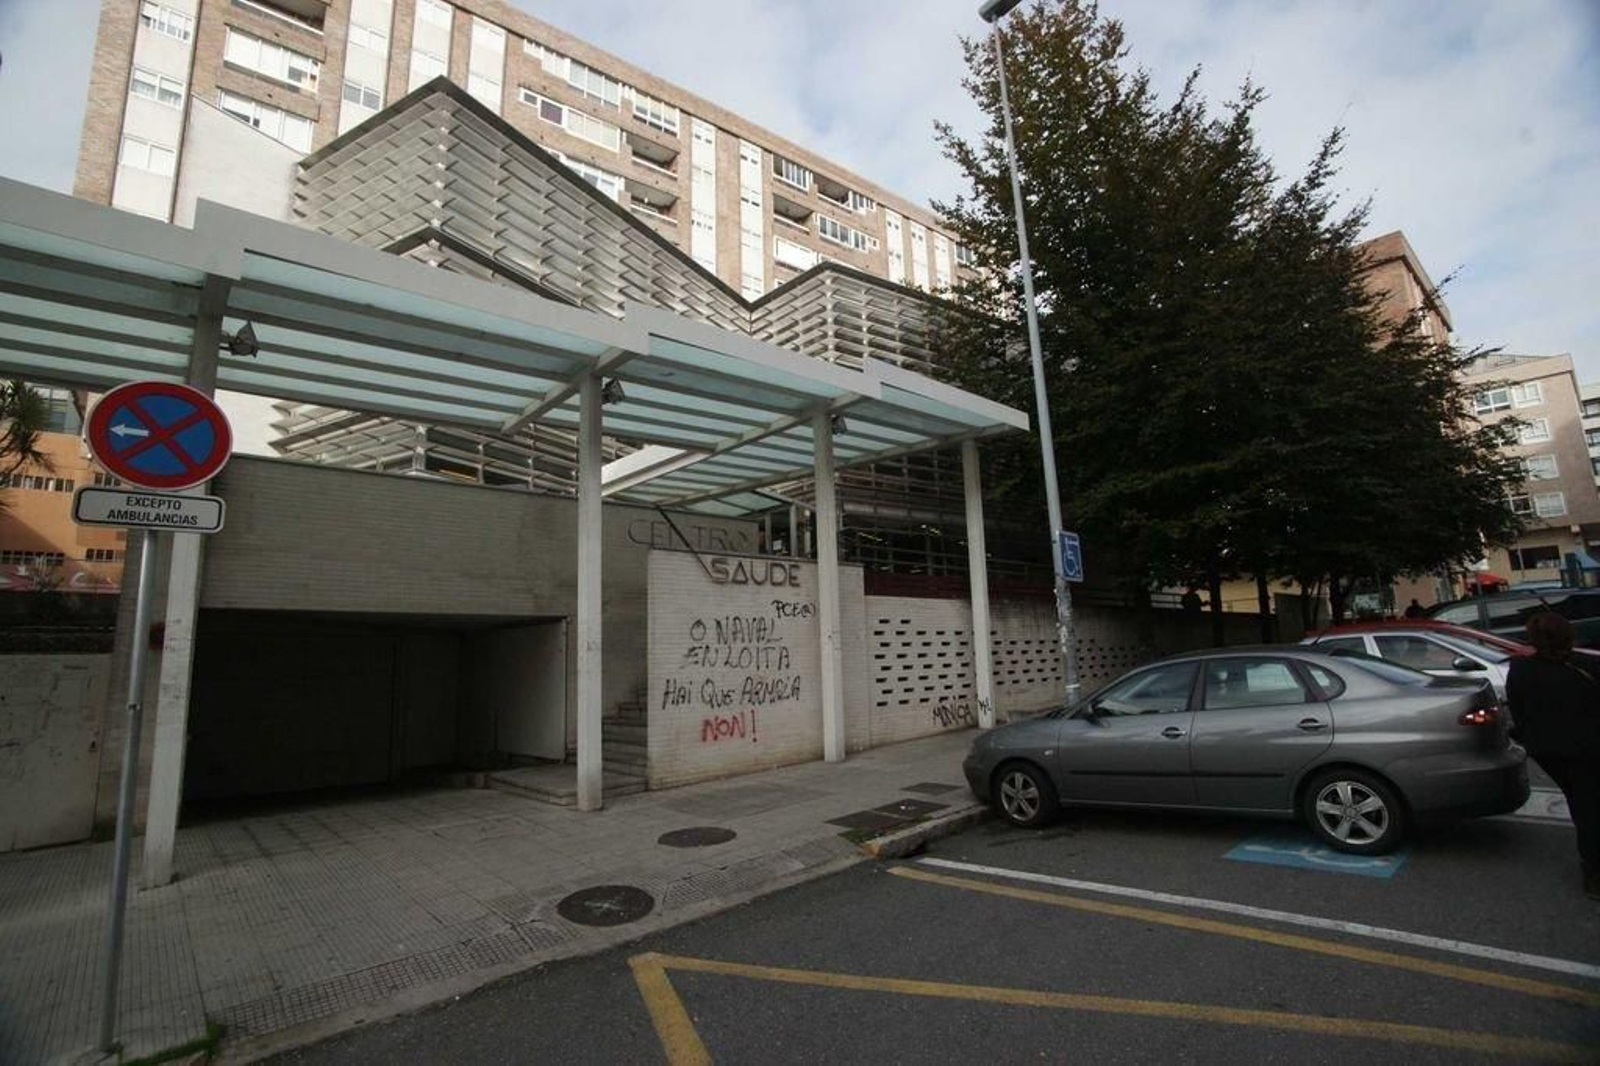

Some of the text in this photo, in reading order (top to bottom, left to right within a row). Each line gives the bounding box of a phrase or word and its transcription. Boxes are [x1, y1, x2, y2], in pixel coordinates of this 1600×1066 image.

[125, 496, 182, 510] EXCEPTO
[106, 508, 198, 526] AMBULANCIAS
[690, 615, 783, 645] O NAVAL
[723, 646, 791, 671] LOITA
